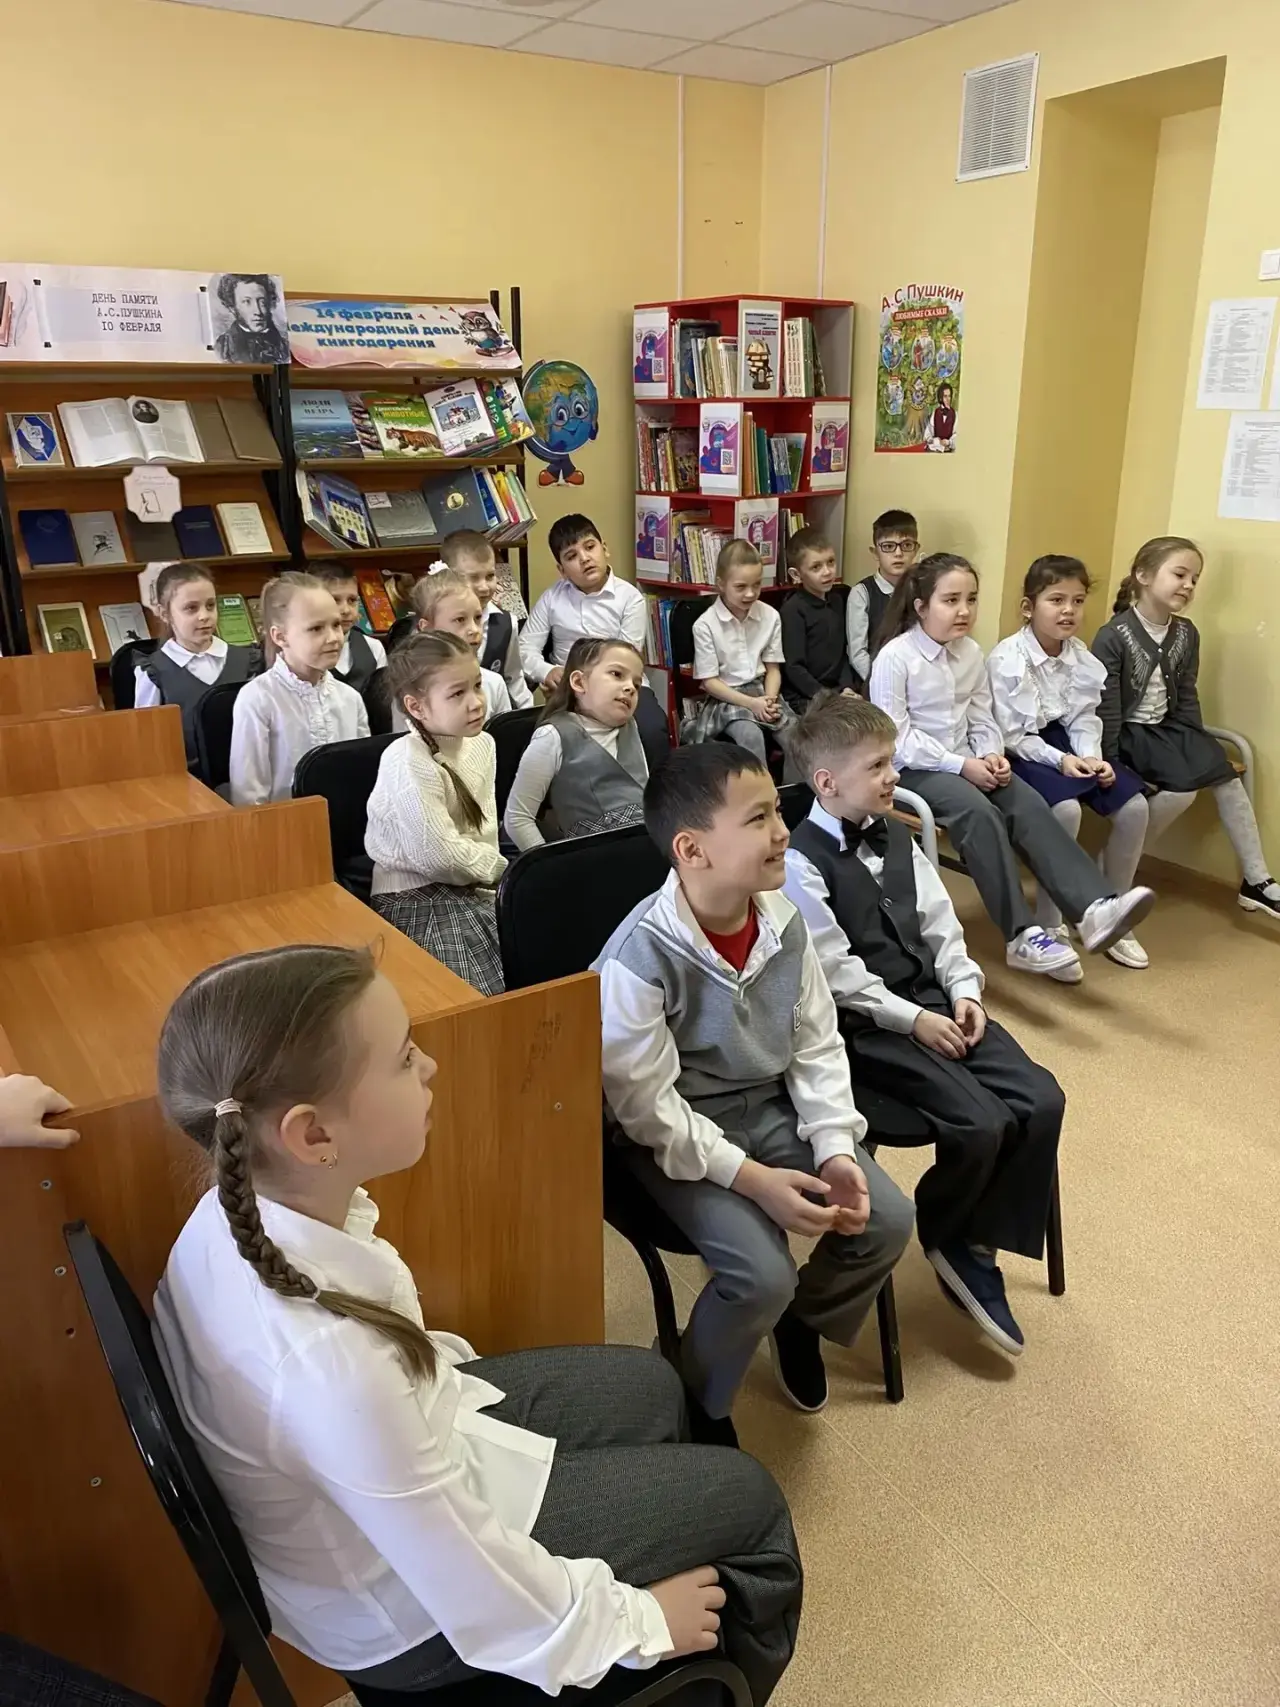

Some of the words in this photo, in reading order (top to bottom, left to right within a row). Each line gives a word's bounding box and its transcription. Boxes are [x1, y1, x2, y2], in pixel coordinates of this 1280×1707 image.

[92, 293, 117, 304] ДЕНЬ
[122, 294, 158, 305] ПАМЯТИ
[97, 307, 163, 319] А.С.ПУШКИНА
[316, 308, 335, 319] 14
[338, 309, 413, 322] февраля
[119, 322, 162, 332] ФЕВРАЛЯ
[287, 321, 419, 336] еждународный
[422, 325, 460, 336] день
[316, 338, 436, 350] книгодарения
